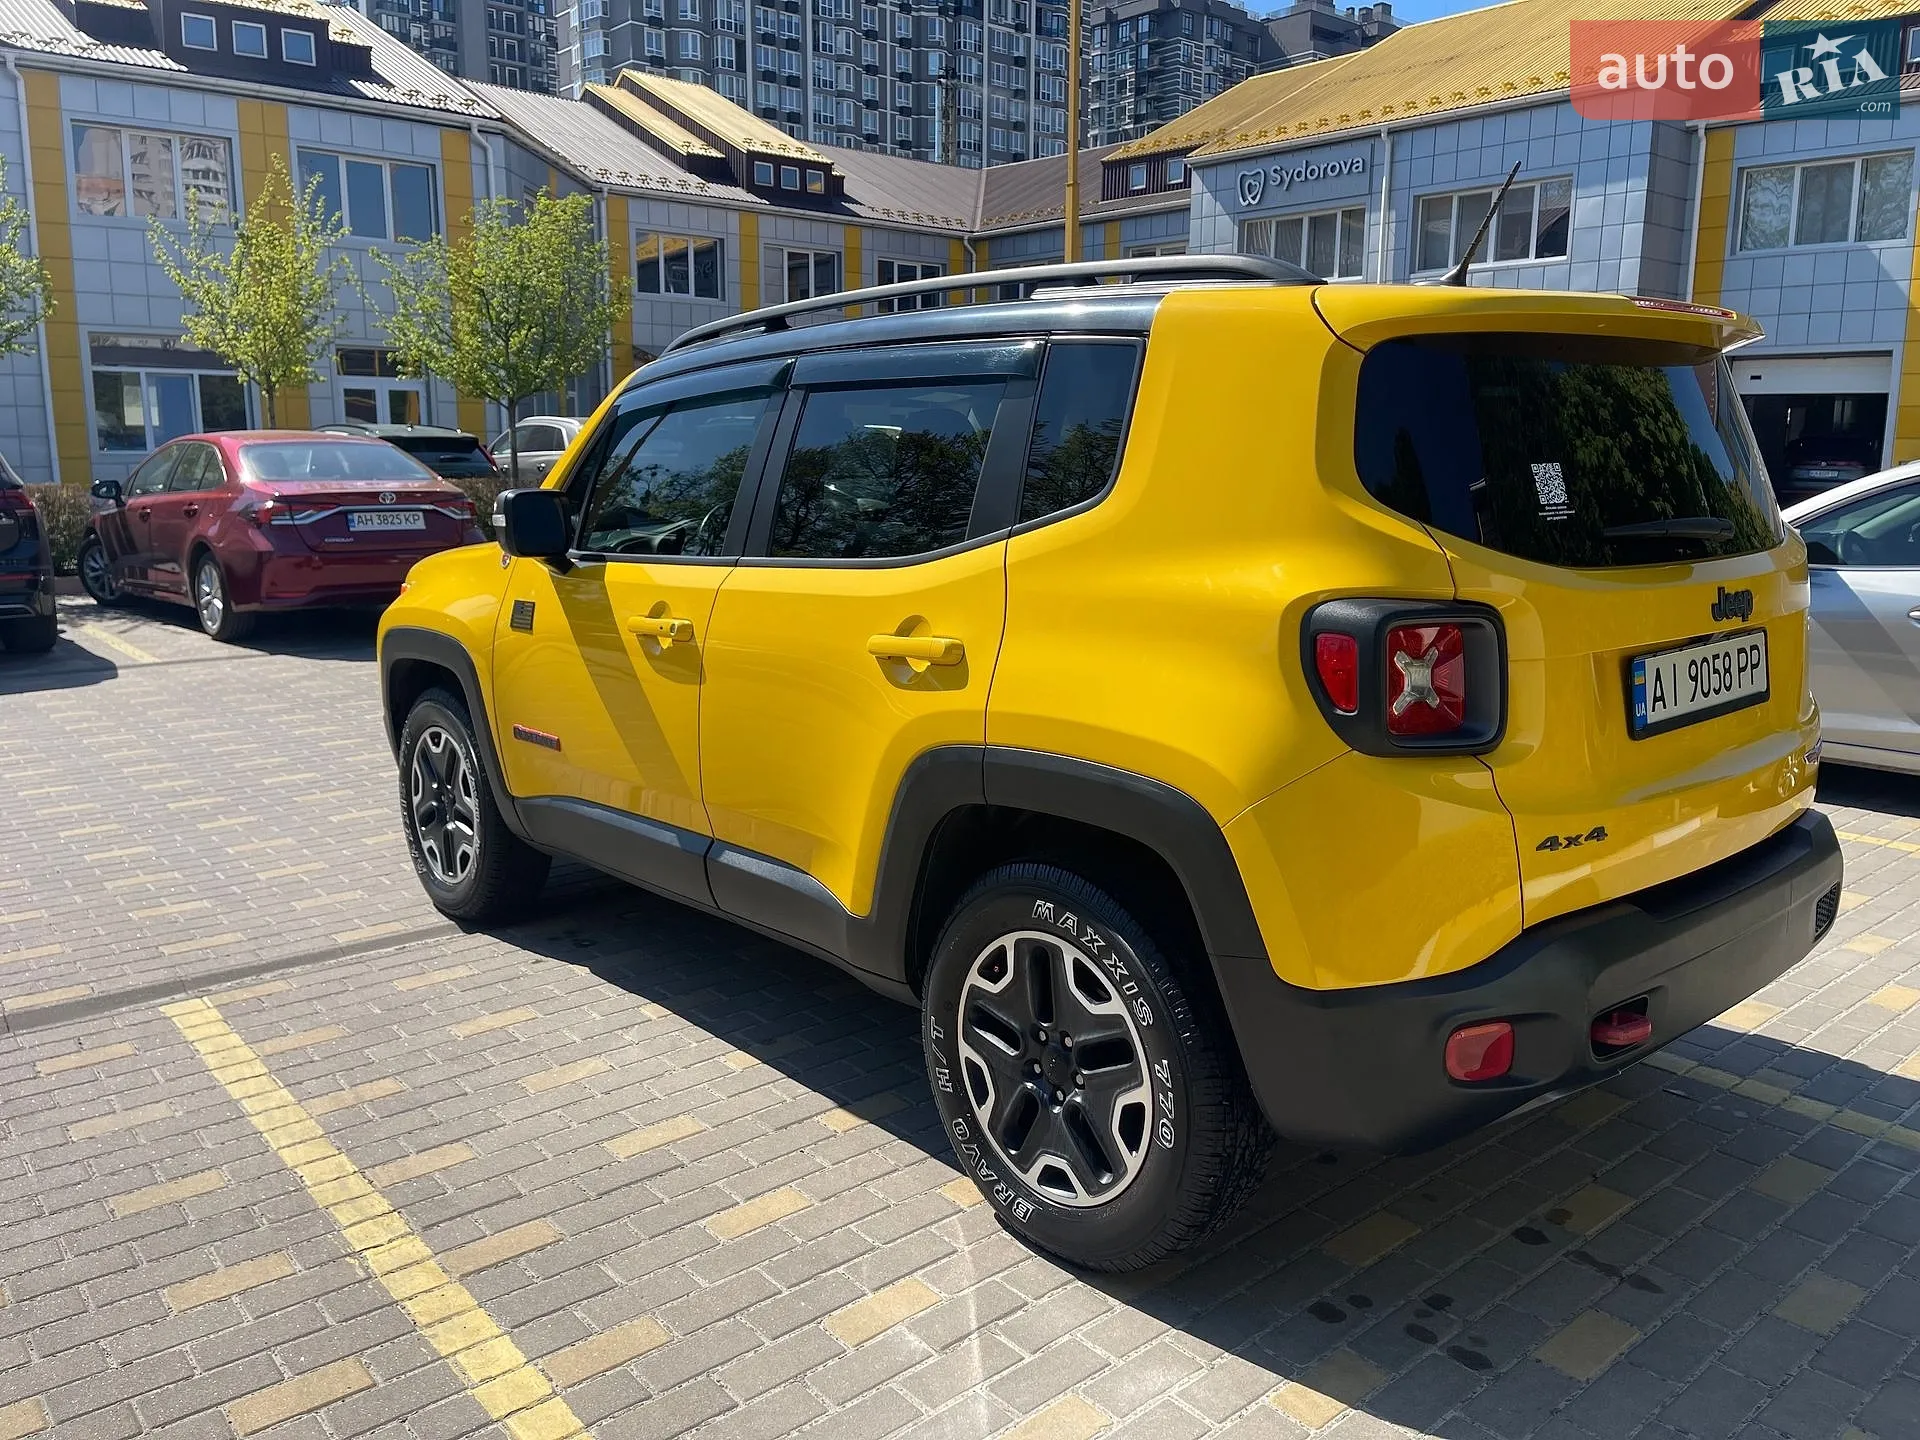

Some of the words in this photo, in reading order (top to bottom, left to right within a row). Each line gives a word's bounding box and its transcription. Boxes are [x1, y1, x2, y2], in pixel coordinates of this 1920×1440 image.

[1269, 157, 1364, 191] Sydorova
[356, 513, 374, 526] AH
[376, 513, 402, 526] 3825
[403, 513, 420, 525] KP
[1711, 586, 1754, 622] Jeep
[1651, 663, 1678, 713] AI
[1688, 651, 1733, 703] 9058
[1737, 644, 1761, 689] PP
[1635, 703, 1647, 718] UA
[1536, 825, 1609, 852] 4x4
[1031, 899, 1154, 1027] MAXXIS
[1153, 1059, 1176, 1149] 770
[930, 1015, 954, 1094] H/T
[952, 1117, 1035, 1224] BRAVO
